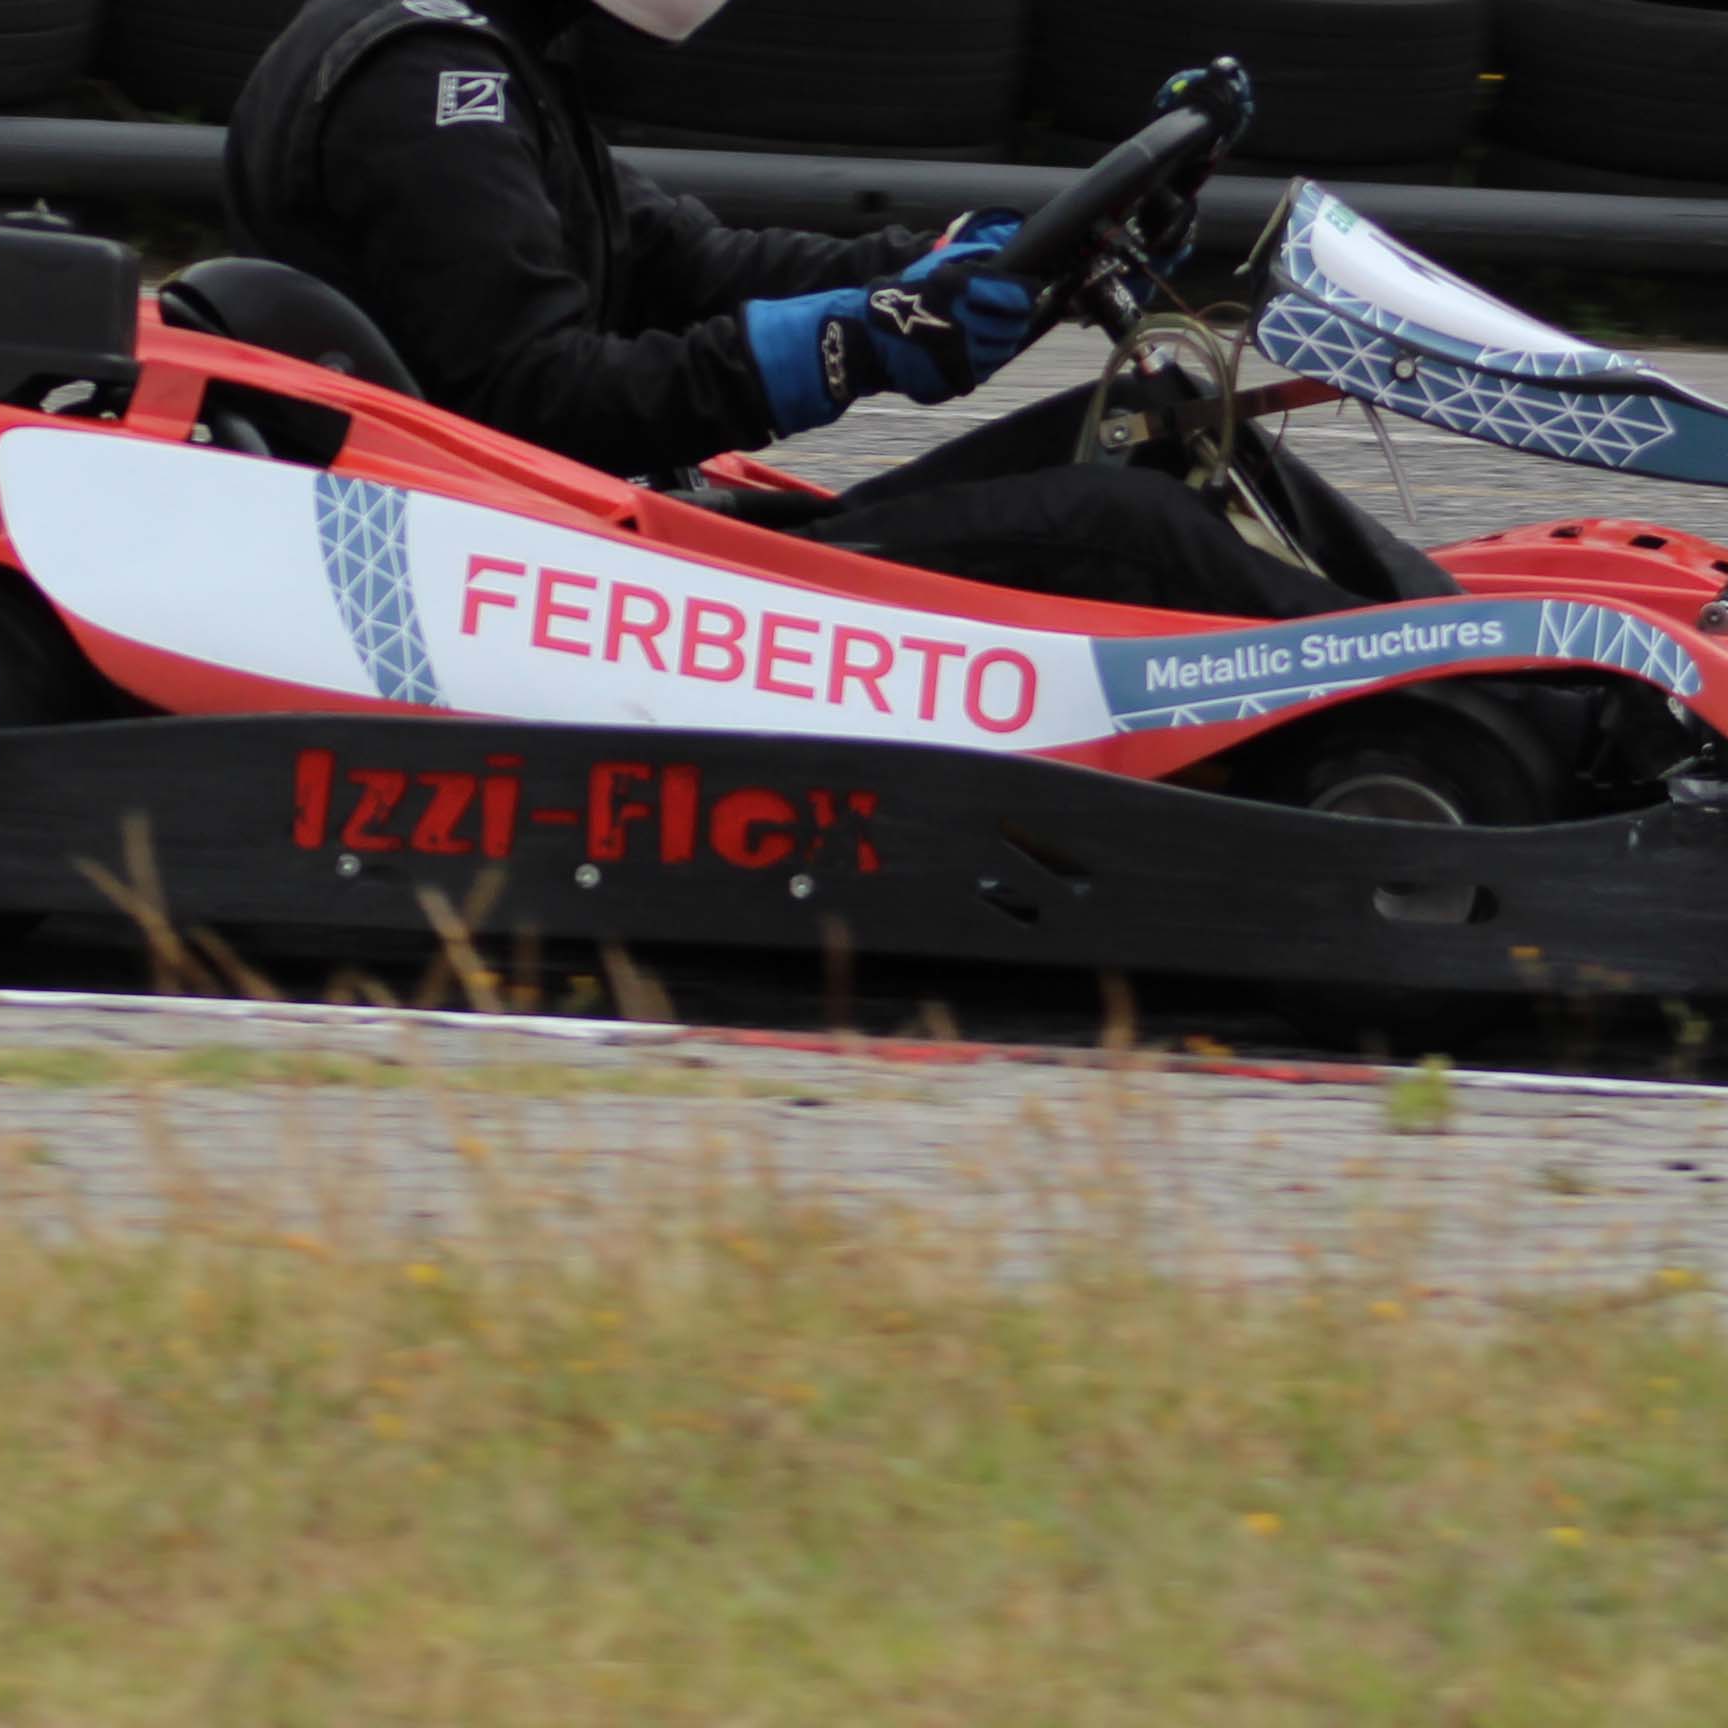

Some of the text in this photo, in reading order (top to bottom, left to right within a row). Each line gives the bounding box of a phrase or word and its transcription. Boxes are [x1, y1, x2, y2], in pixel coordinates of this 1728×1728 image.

[459, 553, 1037, 734] FERBERTO
[1145, 615, 1505, 693] Metallic Structures
